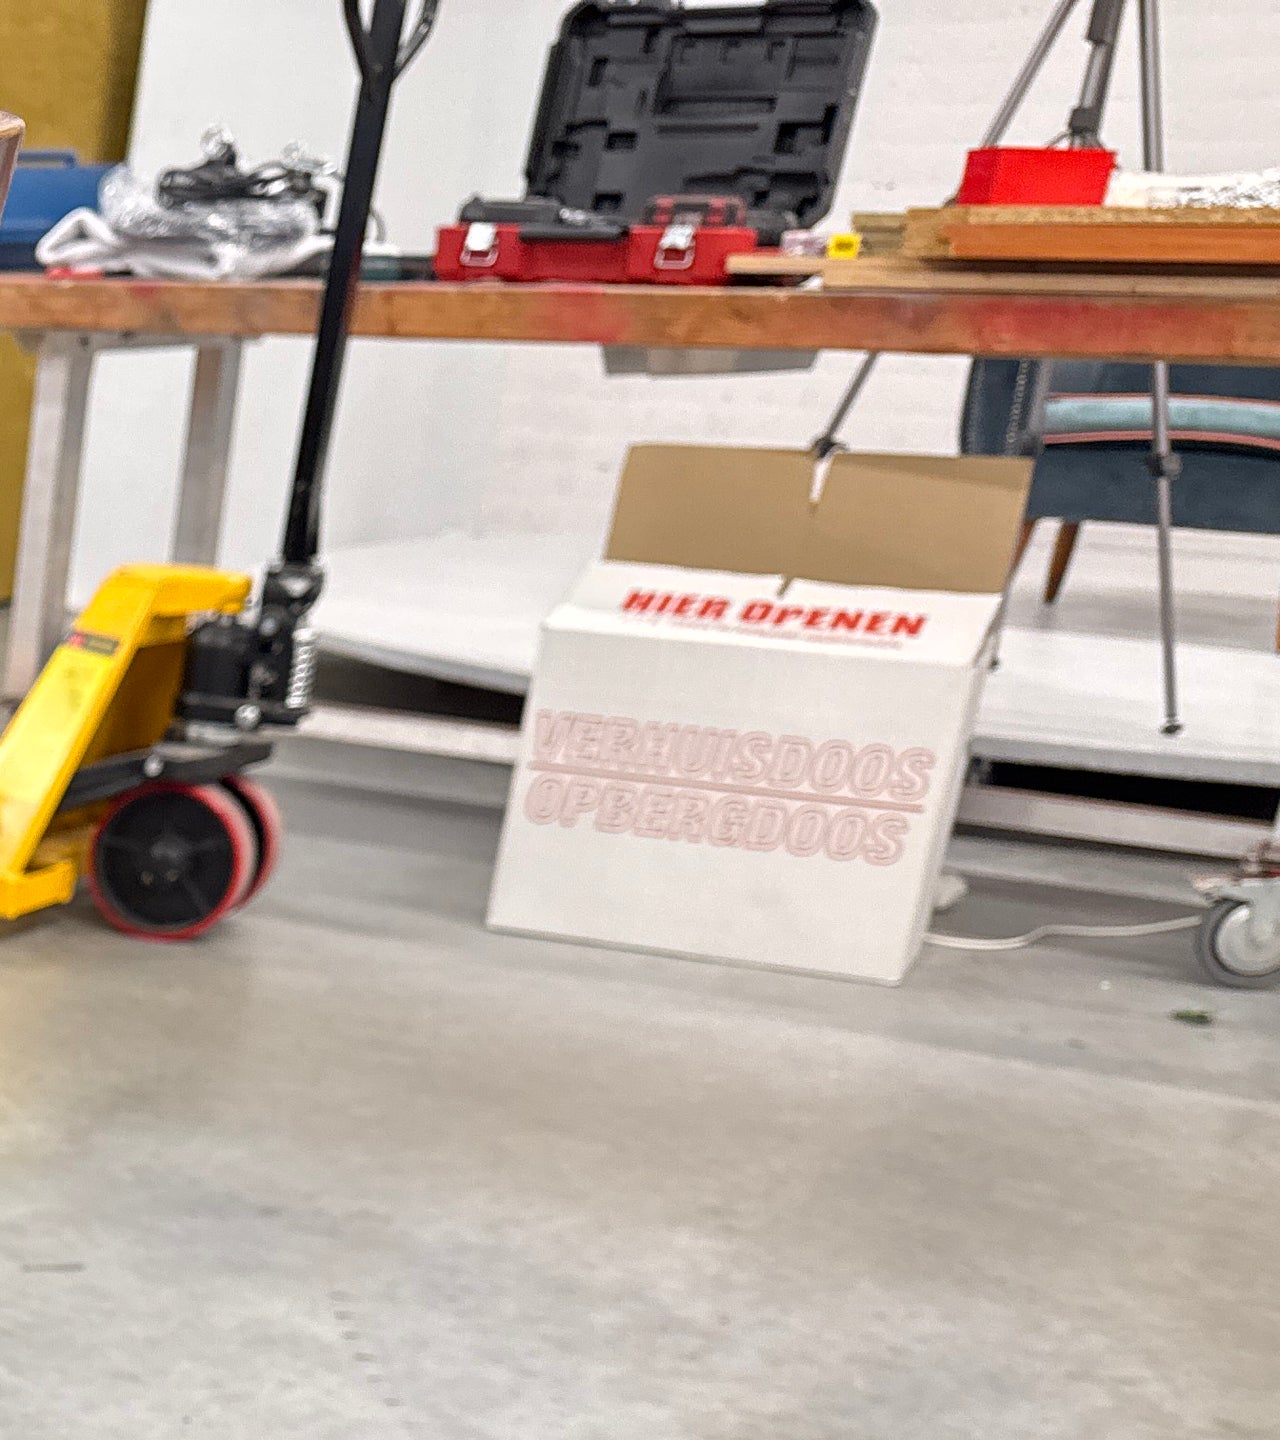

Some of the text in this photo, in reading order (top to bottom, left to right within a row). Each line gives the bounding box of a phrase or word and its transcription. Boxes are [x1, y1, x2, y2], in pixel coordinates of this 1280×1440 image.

[621, 589, 731, 621] HIER
[740, 601, 928, 638] OPENEN
[534, 709, 936, 801] VERHUISDOOS
[524, 773, 911, 867] OPBERGDOOS
